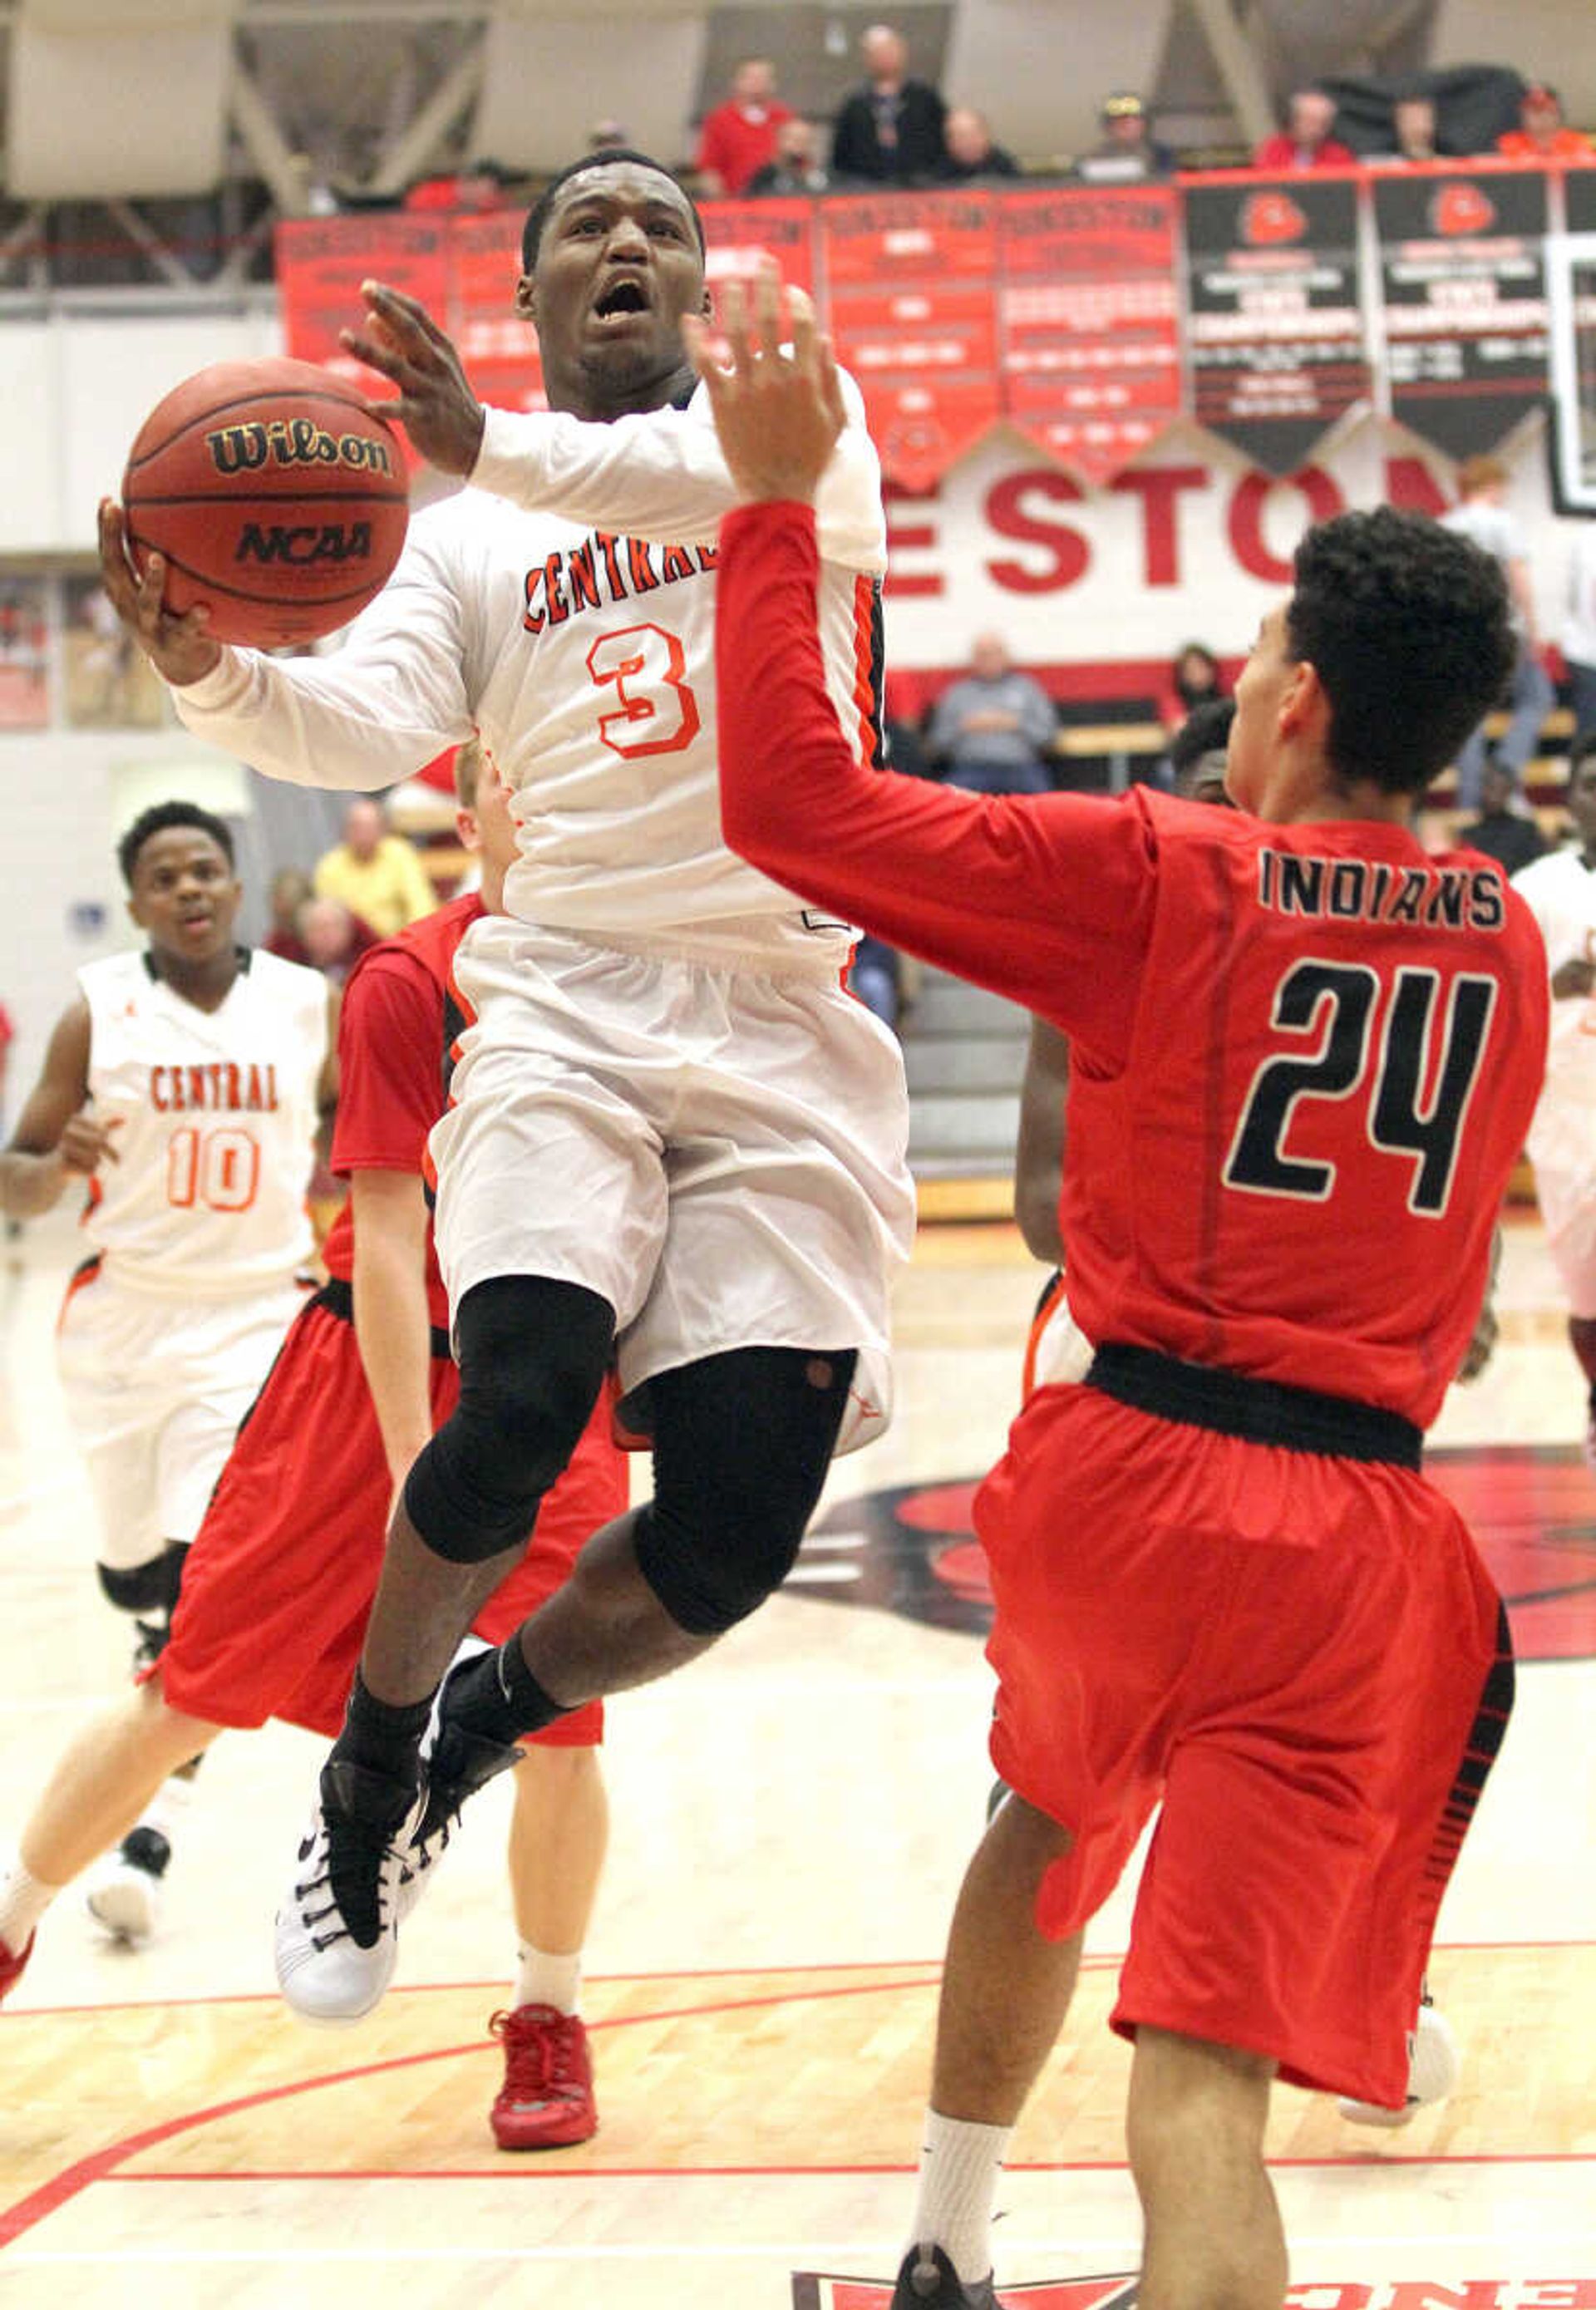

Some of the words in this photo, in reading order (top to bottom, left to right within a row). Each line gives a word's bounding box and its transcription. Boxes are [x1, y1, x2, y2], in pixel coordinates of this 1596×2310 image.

[207, 419, 393, 479] Wilson
[234, 520, 372, 565] NCAA
[585, 622, 701, 759] 3
[1258, 847, 1505, 932] INDIANS
[150, 1061, 278, 1113] CENTRAL
[1221, 957, 1497, 1219] 24
[168, 1126, 261, 1213] 10
